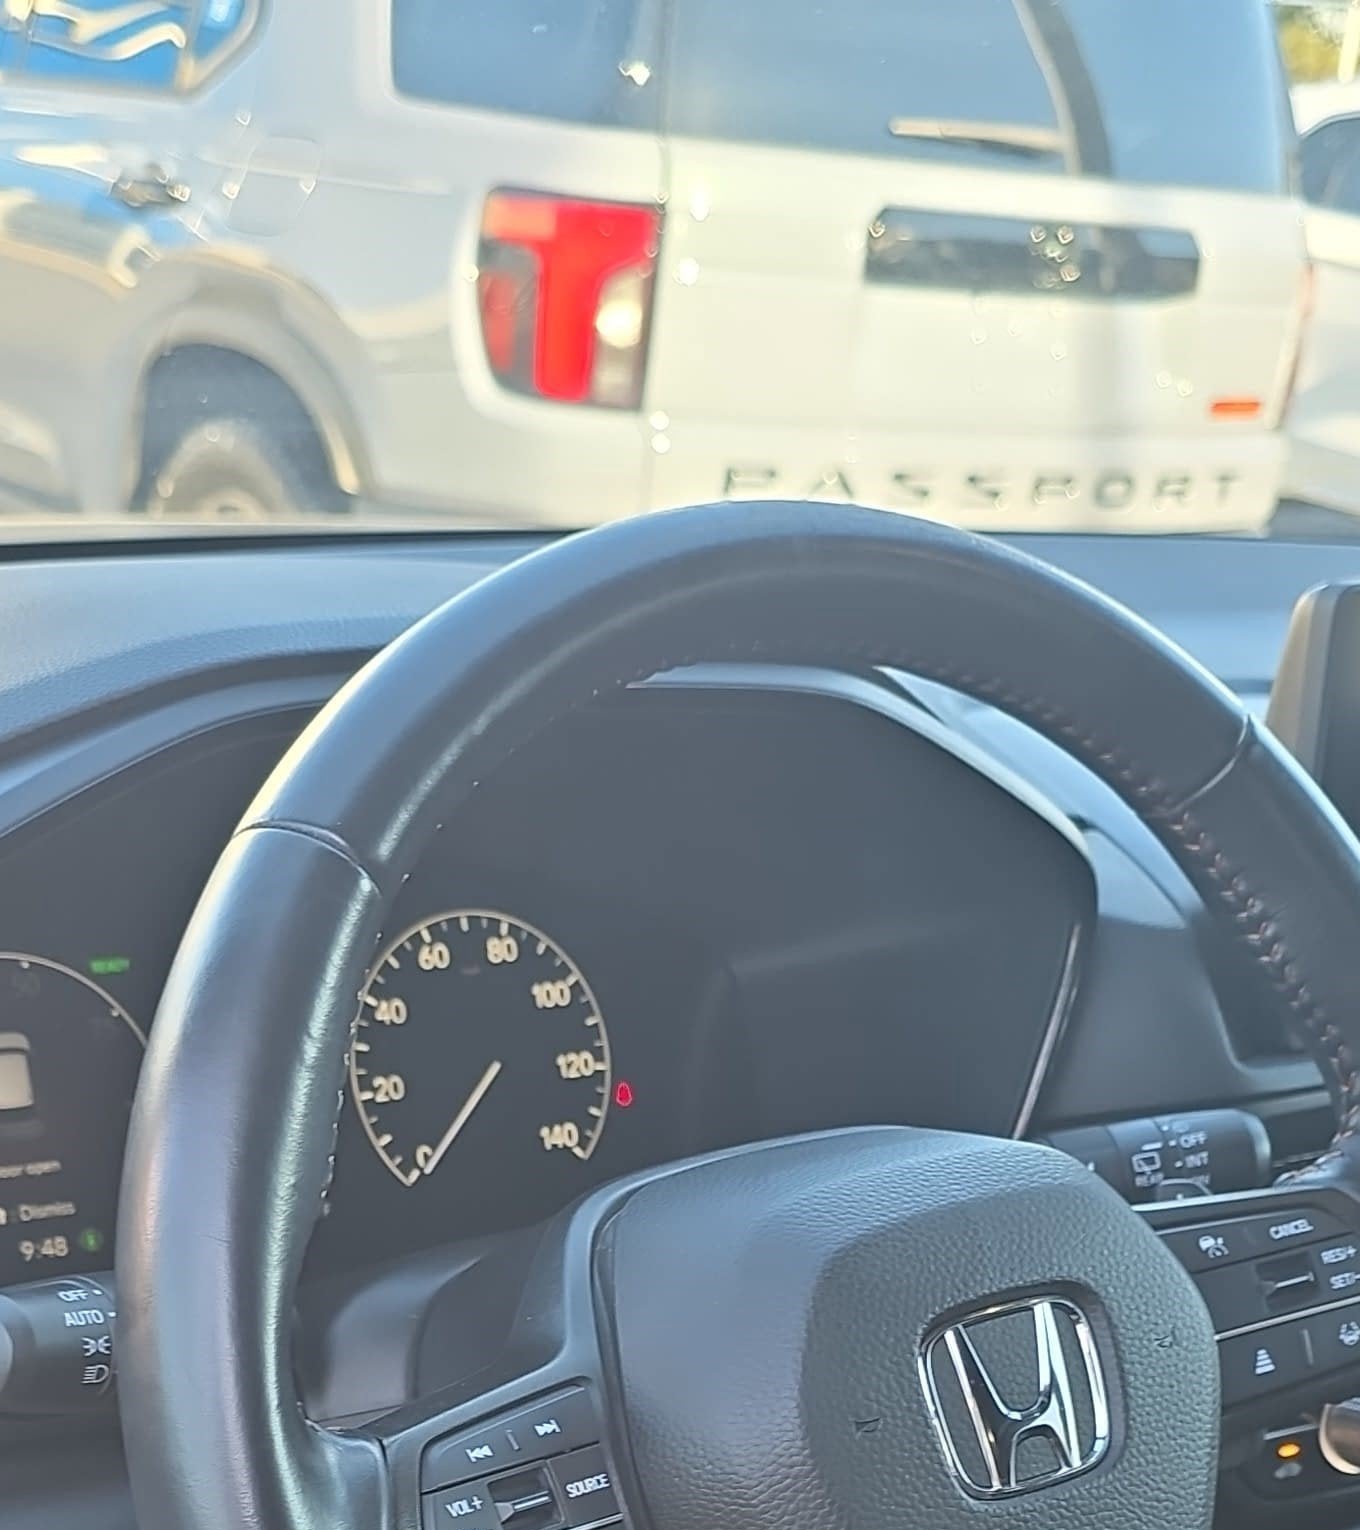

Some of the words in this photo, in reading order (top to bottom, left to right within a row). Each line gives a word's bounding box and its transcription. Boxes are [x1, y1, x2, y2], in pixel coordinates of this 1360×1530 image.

[721, 465, 1242, 513] PASSPORT
[417, 942, 450, 970] 60
[486, 936, 519, 965] 80
[531, 981, 571, 1009] 100
[374, 998, 408, 1025] 40
[556, 1051, 595, 1079] 120
[372, 1074, 405, 1103] 20
[540, 1122, 579, 1150] 140
[1269, 1218, 1315, 1240] CANCEL
[19, 1235, 69, 1262] 9:48
[57, 1289, 89, 1302] OFF
[63, 1309, 105, 1327] AUTO
[565, 1473, 611, 1499] SOURCE
